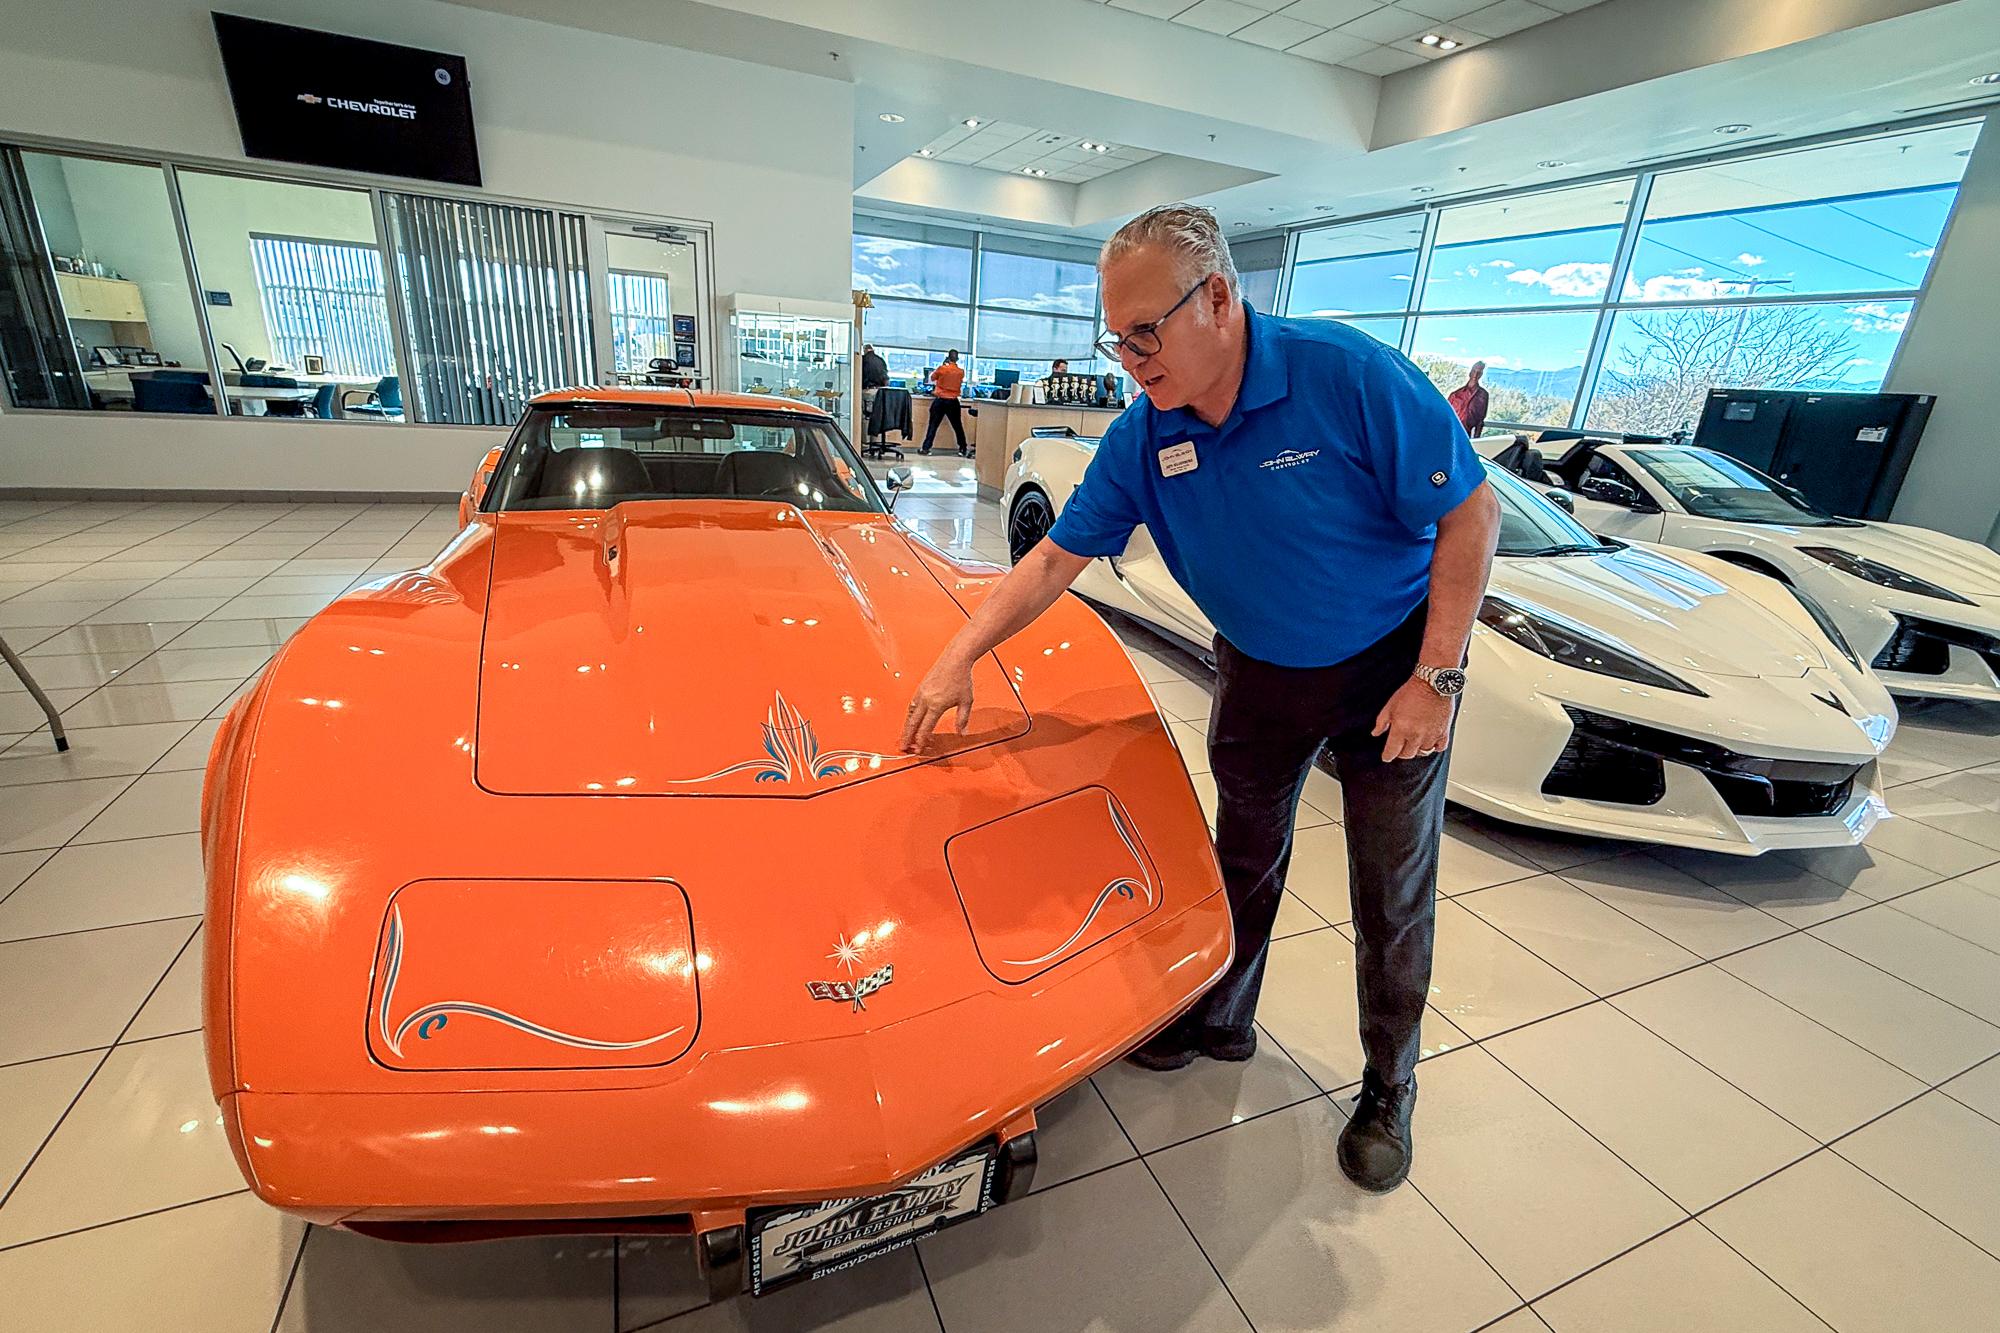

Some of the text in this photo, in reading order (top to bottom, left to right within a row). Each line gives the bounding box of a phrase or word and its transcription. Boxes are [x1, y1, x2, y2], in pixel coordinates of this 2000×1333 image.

[326, 97, 417, 119] CHEVROLET
[1259, 449, 1320, 468] JOHN ELWAY
[980, 1159, 996, 1213] ENGLEWOOD
[772, 1210, 868, 1257] JOHN
[867, 1172, 975, 1222] ELWAY
[822, 1206, 929, 1250] DEALERSHIPS
[751, 1235, 761, 1296] CHEVROLET
